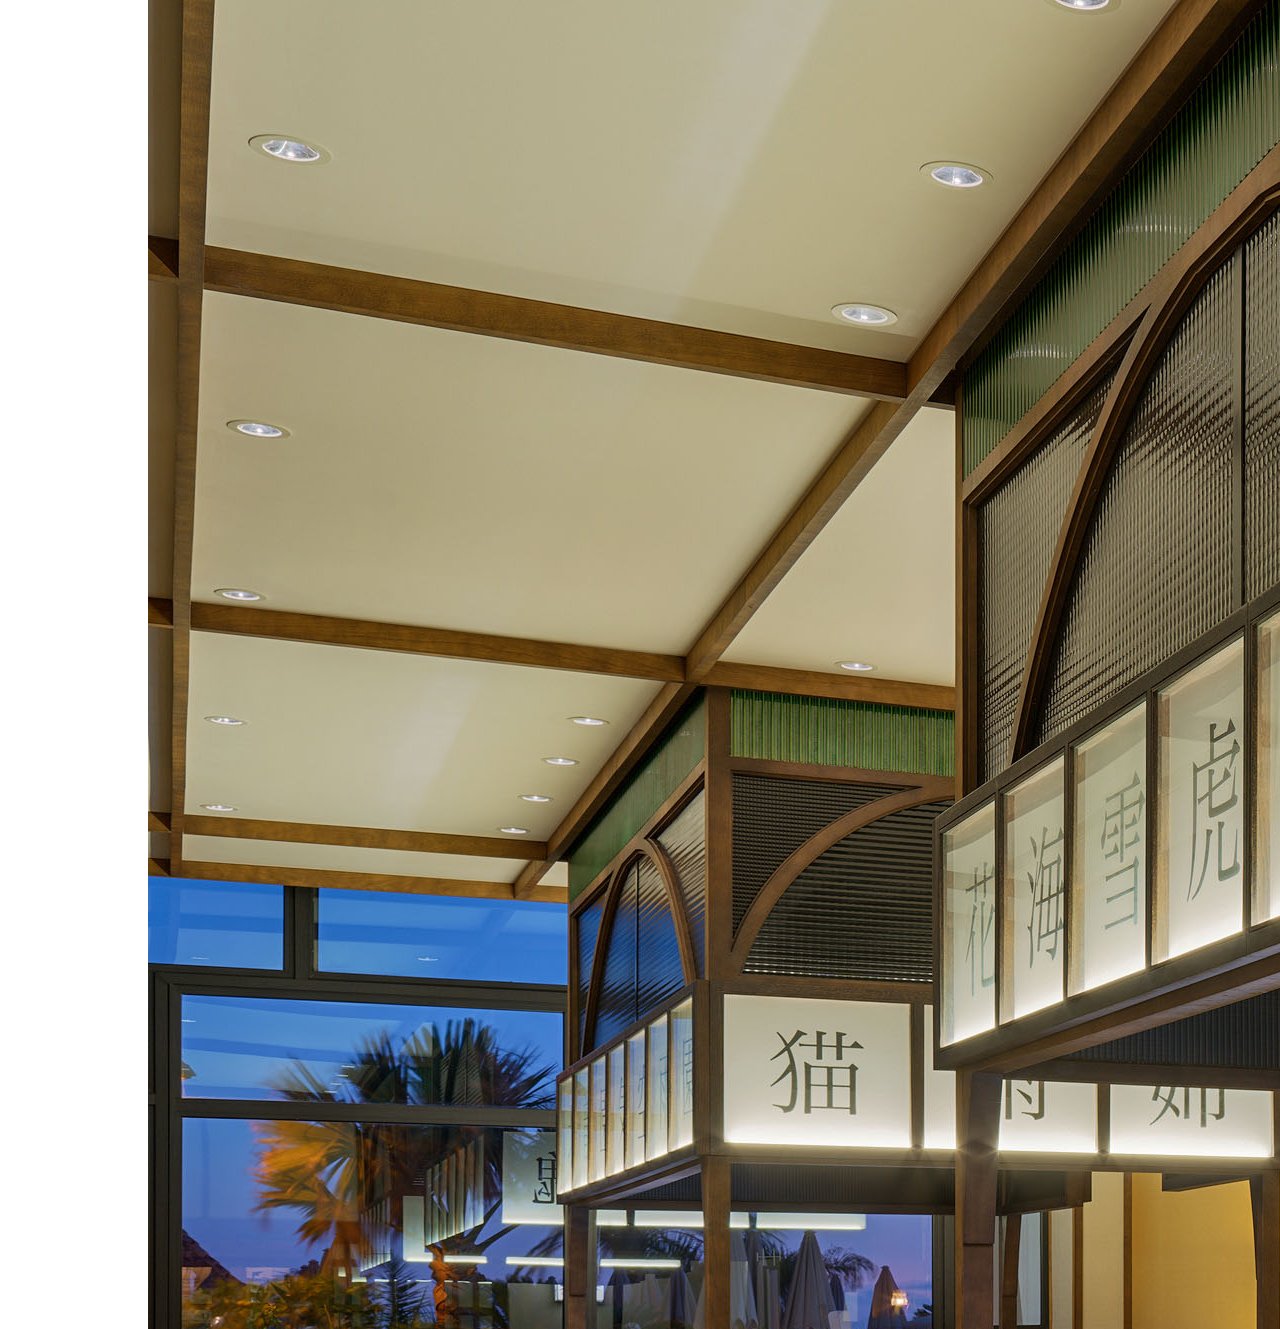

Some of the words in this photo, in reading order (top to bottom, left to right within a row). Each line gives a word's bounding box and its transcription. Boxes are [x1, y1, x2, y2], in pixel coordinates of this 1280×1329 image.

[1101, 772, 1145, 930] 雪
[1187, 717, 1241, 903] 虎
[965, 861, 995, 997] 花
[1027, 826, 1064, 969] 海
[770, 1030, 865, 1115] 猫
